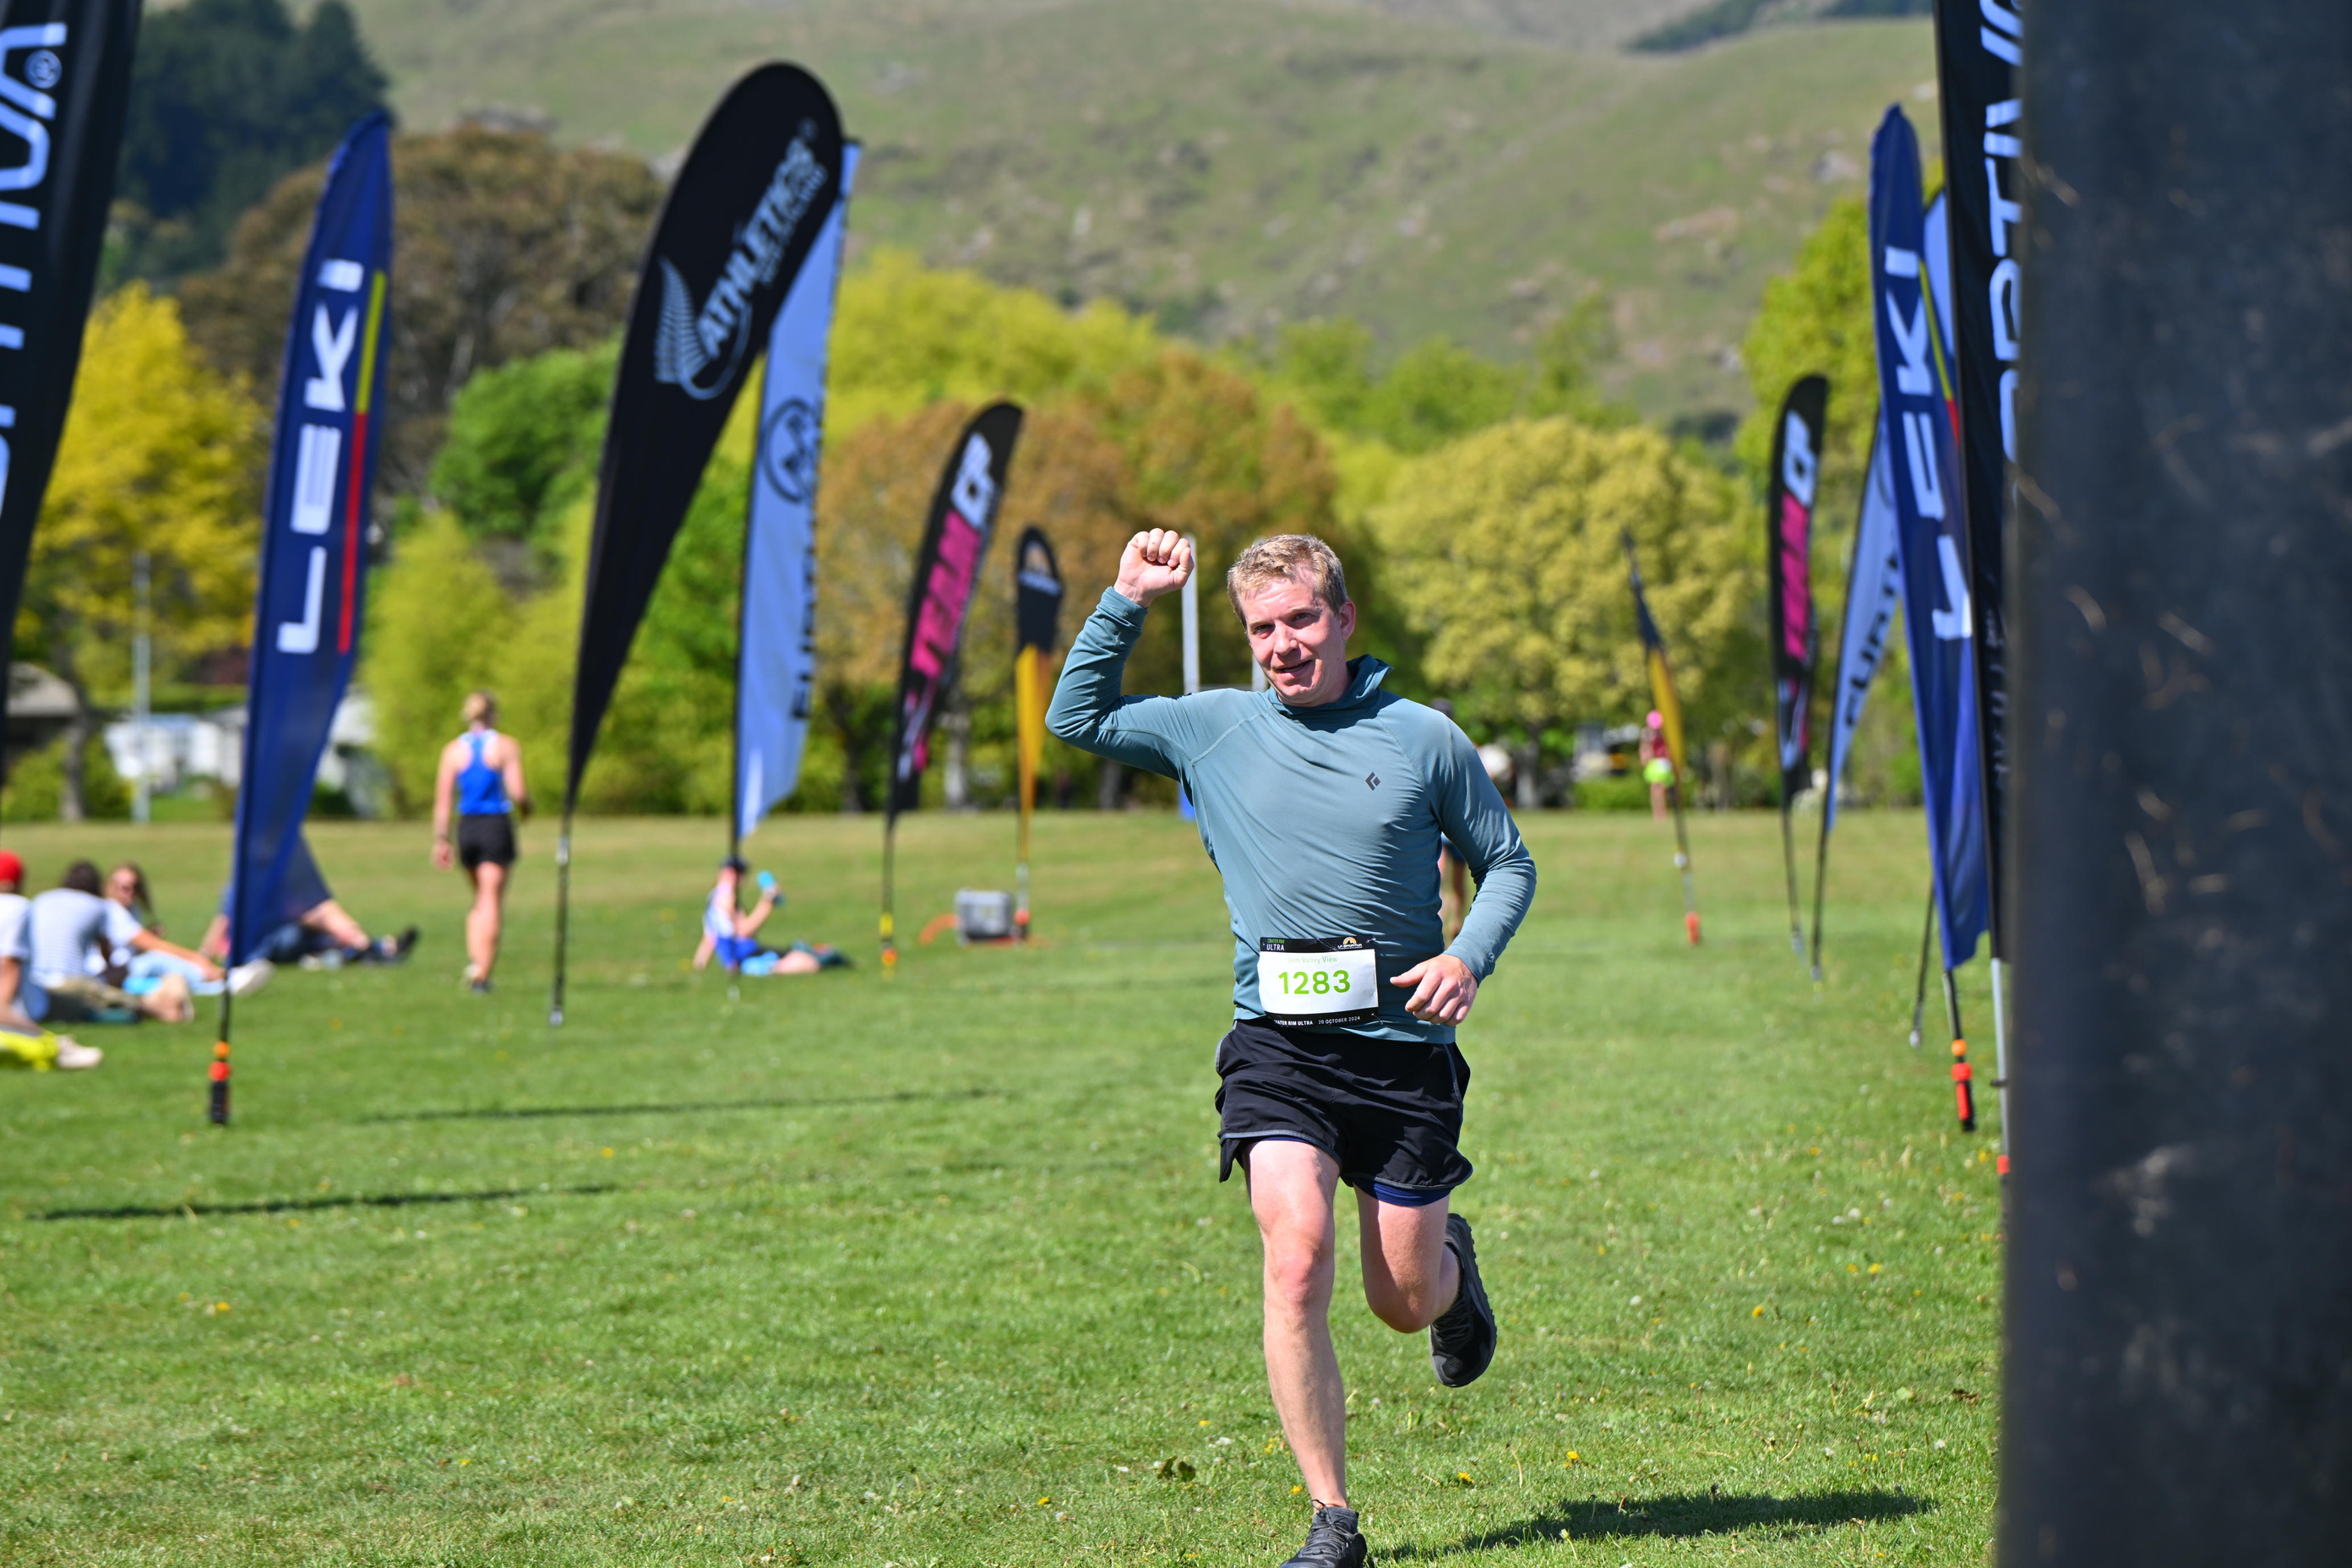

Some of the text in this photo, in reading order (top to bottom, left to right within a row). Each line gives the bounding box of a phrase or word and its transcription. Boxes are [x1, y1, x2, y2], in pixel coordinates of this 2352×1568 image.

[698, 135, 815, 359] ATHLETICS
[277, 259, 364, 654] LEKI
[1885, 246, 1972, 640] LEKI
[1278, 970, 1350, 994] 1283
